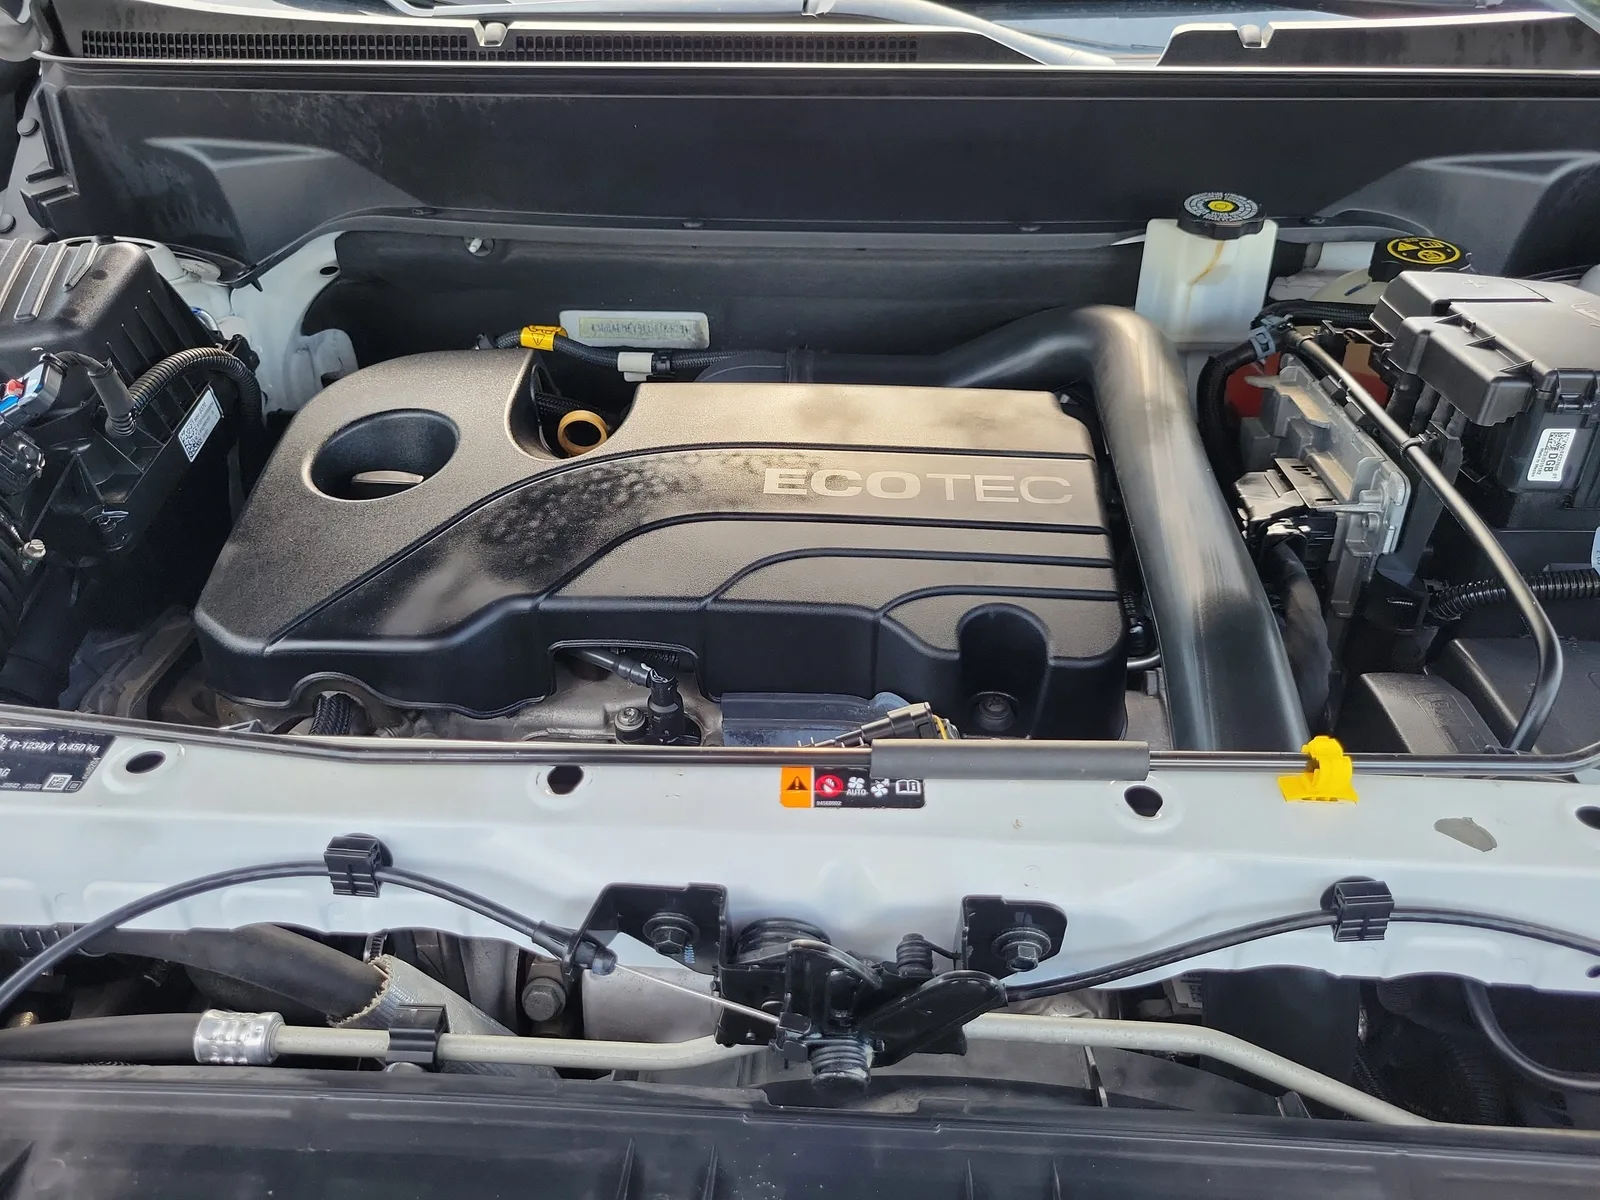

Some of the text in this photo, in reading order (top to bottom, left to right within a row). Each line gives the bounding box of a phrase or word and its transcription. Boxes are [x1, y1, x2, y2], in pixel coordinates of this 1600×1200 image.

[1543, 453, 1558, 472] DGB
[763, 467, 1074, 504] ECOTEC
[9, 740, 101, 753] R-1234yf 0.450 kg
[846, 788, 867, 796] AUTO
